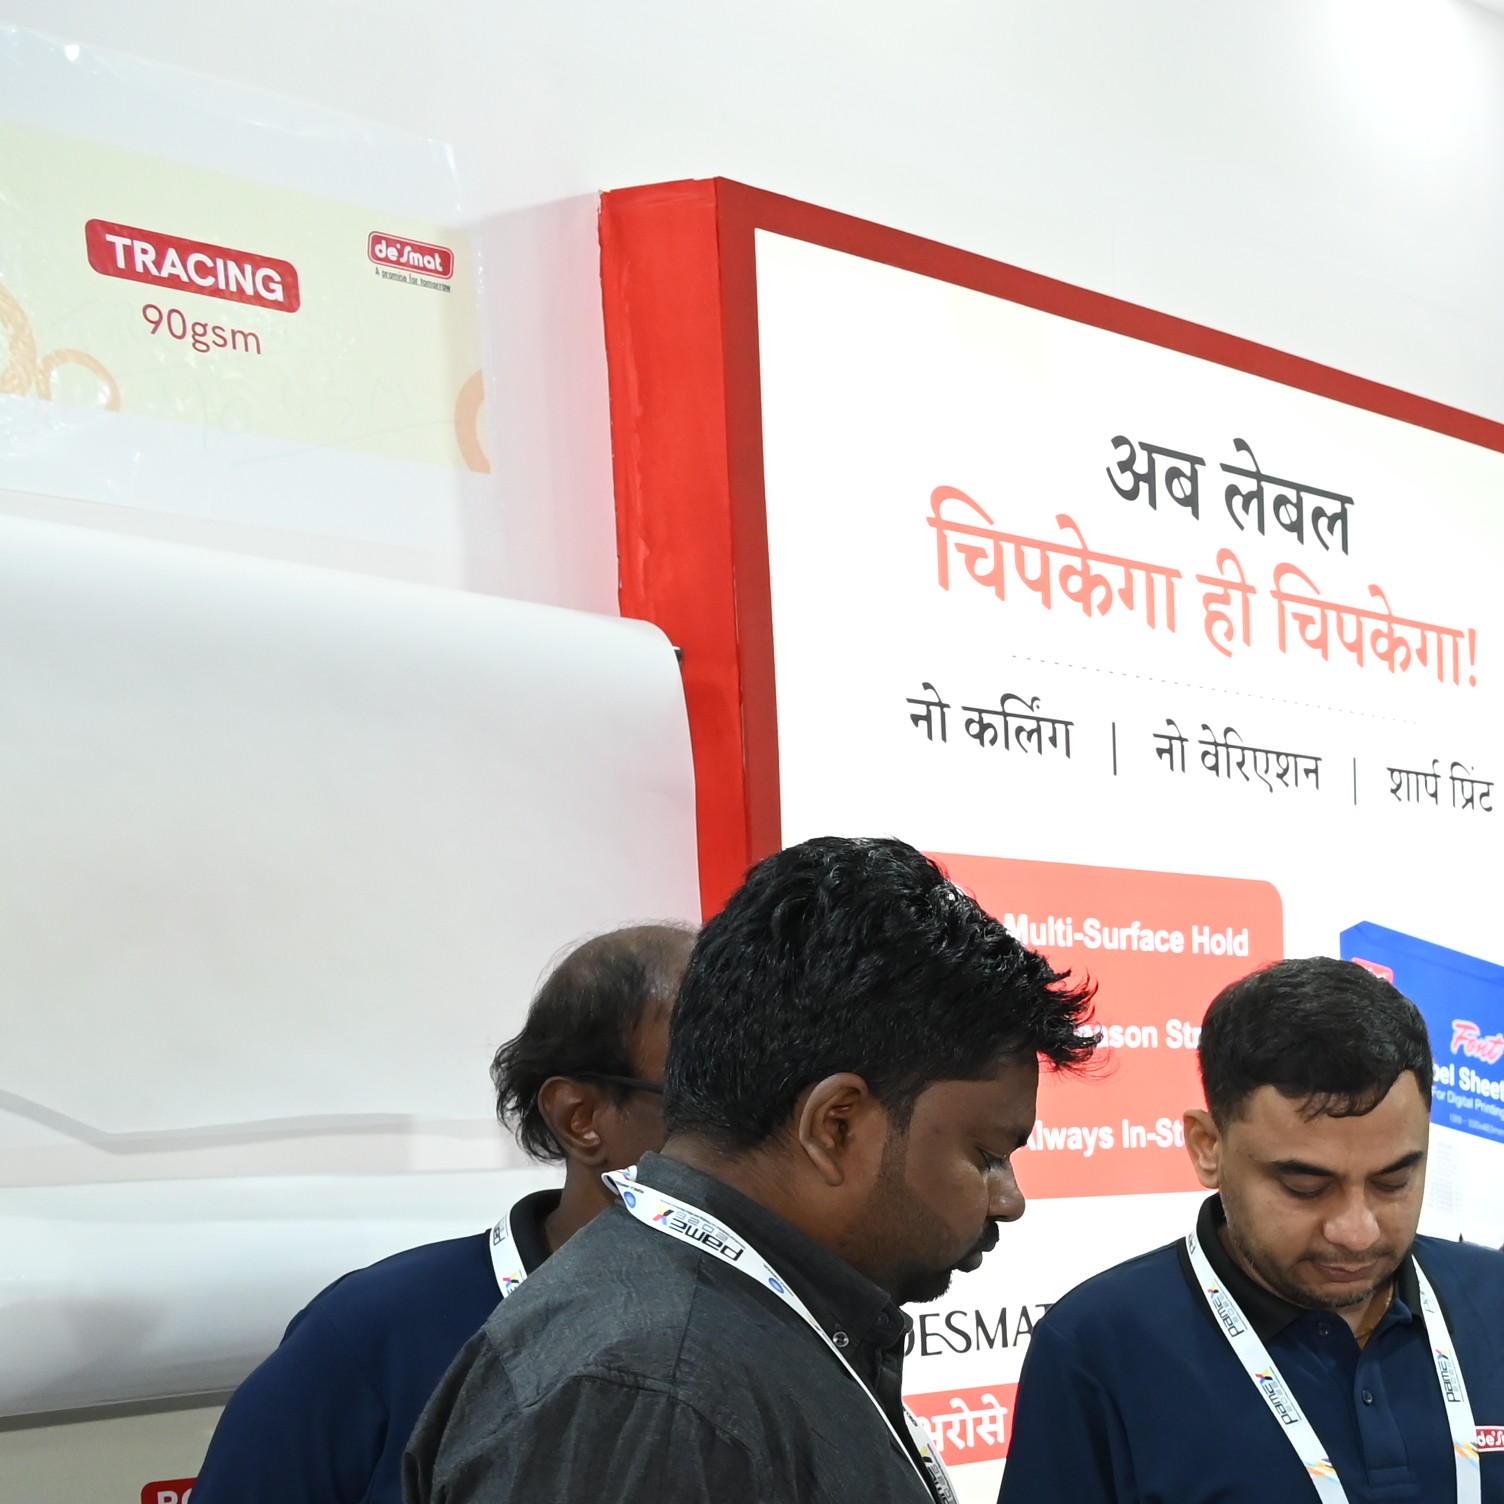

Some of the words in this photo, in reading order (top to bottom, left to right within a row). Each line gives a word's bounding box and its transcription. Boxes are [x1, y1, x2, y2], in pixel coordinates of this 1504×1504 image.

[105, 233, 284, 302] TRACING
[141, 303, 262, 355] 90gsm
[1106, 434, 1205, 520] अब
[1220, 437, 1354, 557] लेबल
[926, 485, 1182, 634] चिपकेगा
[1197, 547, 1256, 658] ही
[1270, 562, 1478, 688] चिपकेगा!
[907, 682, 950, 742] नो
[961, 692, 1074, 759] कर्लिंग
[1153, 718, 1189, 773] नो
[1198, 723, 1322, 793] वेरिएशन
[1387, 758, 1440, 806] शार्प
[1449, 761, 1495, 813] प्रिंट
[1003, 912, 1184, 954] Multi-Surface
[1191, 925, 1249, 957] Hold
[1447, 1092, 1473, 1110] Digital
[1027, 1119, 1115, 1157] Always
[1121, 1118, 1185, 1149] In-St
[904, 1302, 1055, 1357] ESMAT
